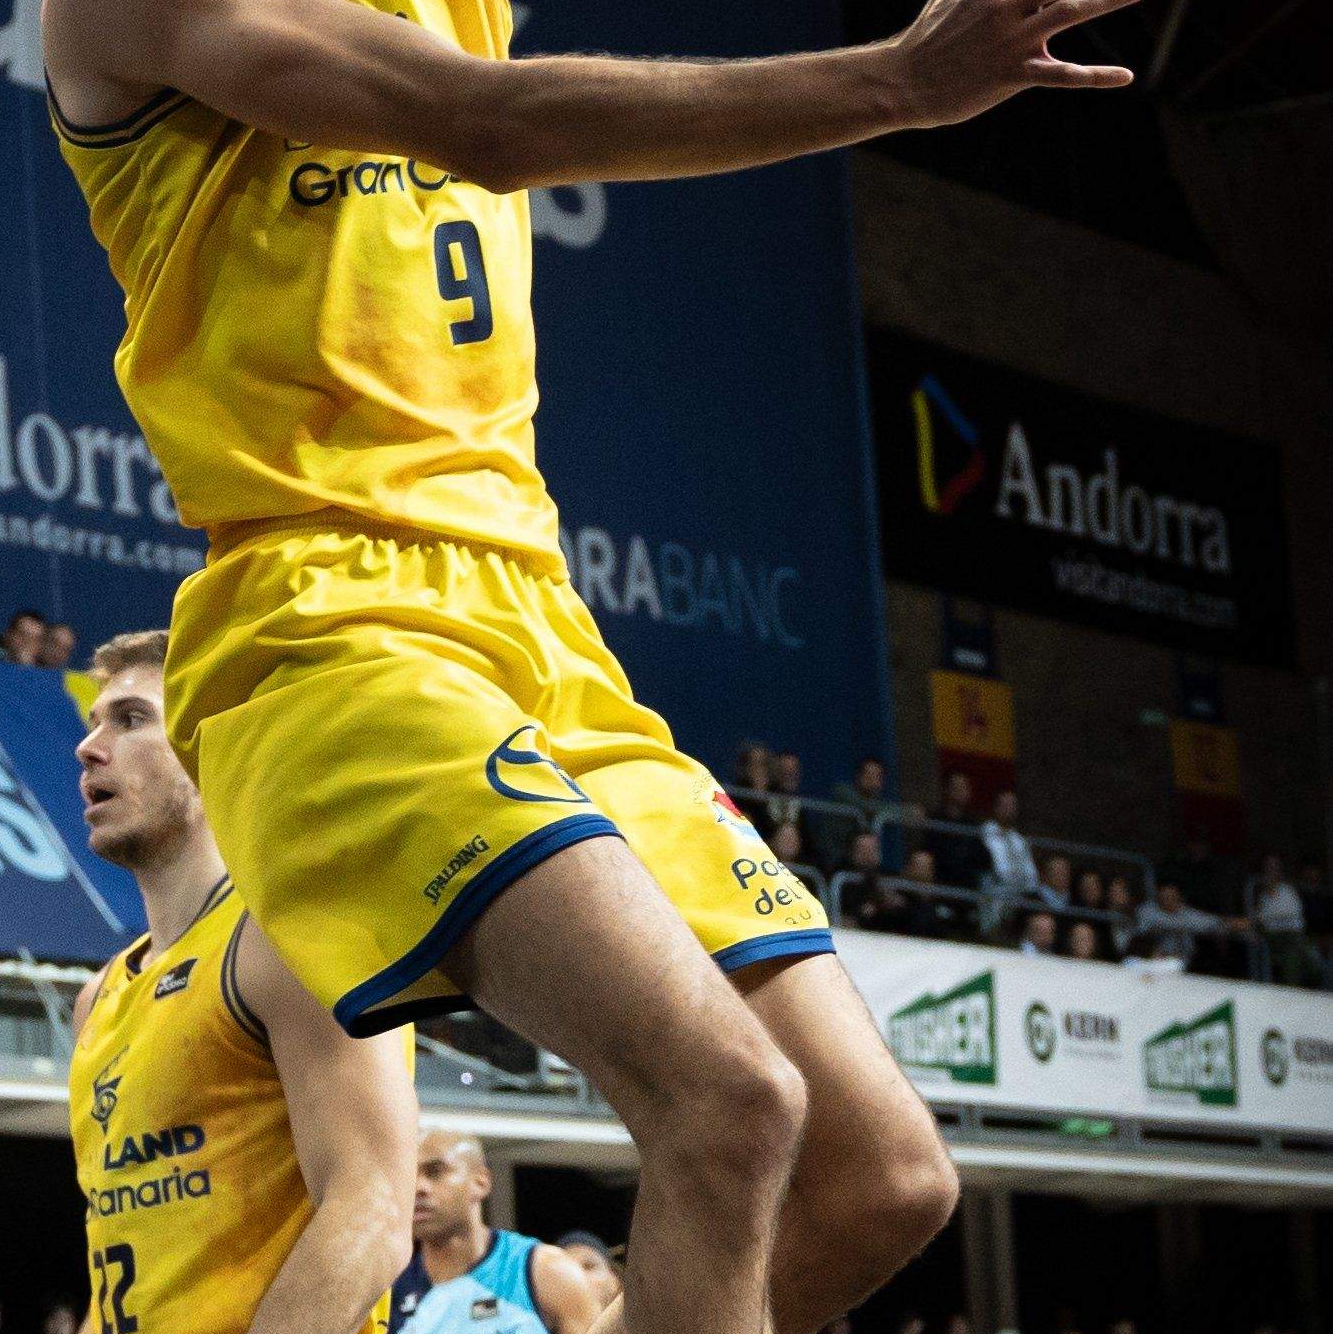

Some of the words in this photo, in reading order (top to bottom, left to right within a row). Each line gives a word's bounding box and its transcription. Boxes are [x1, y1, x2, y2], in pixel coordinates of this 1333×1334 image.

[434, 220, 494, 347] 9
[994, 419, 1232, 574] Andorra
[423, 833, 490, 906] SPALDING
